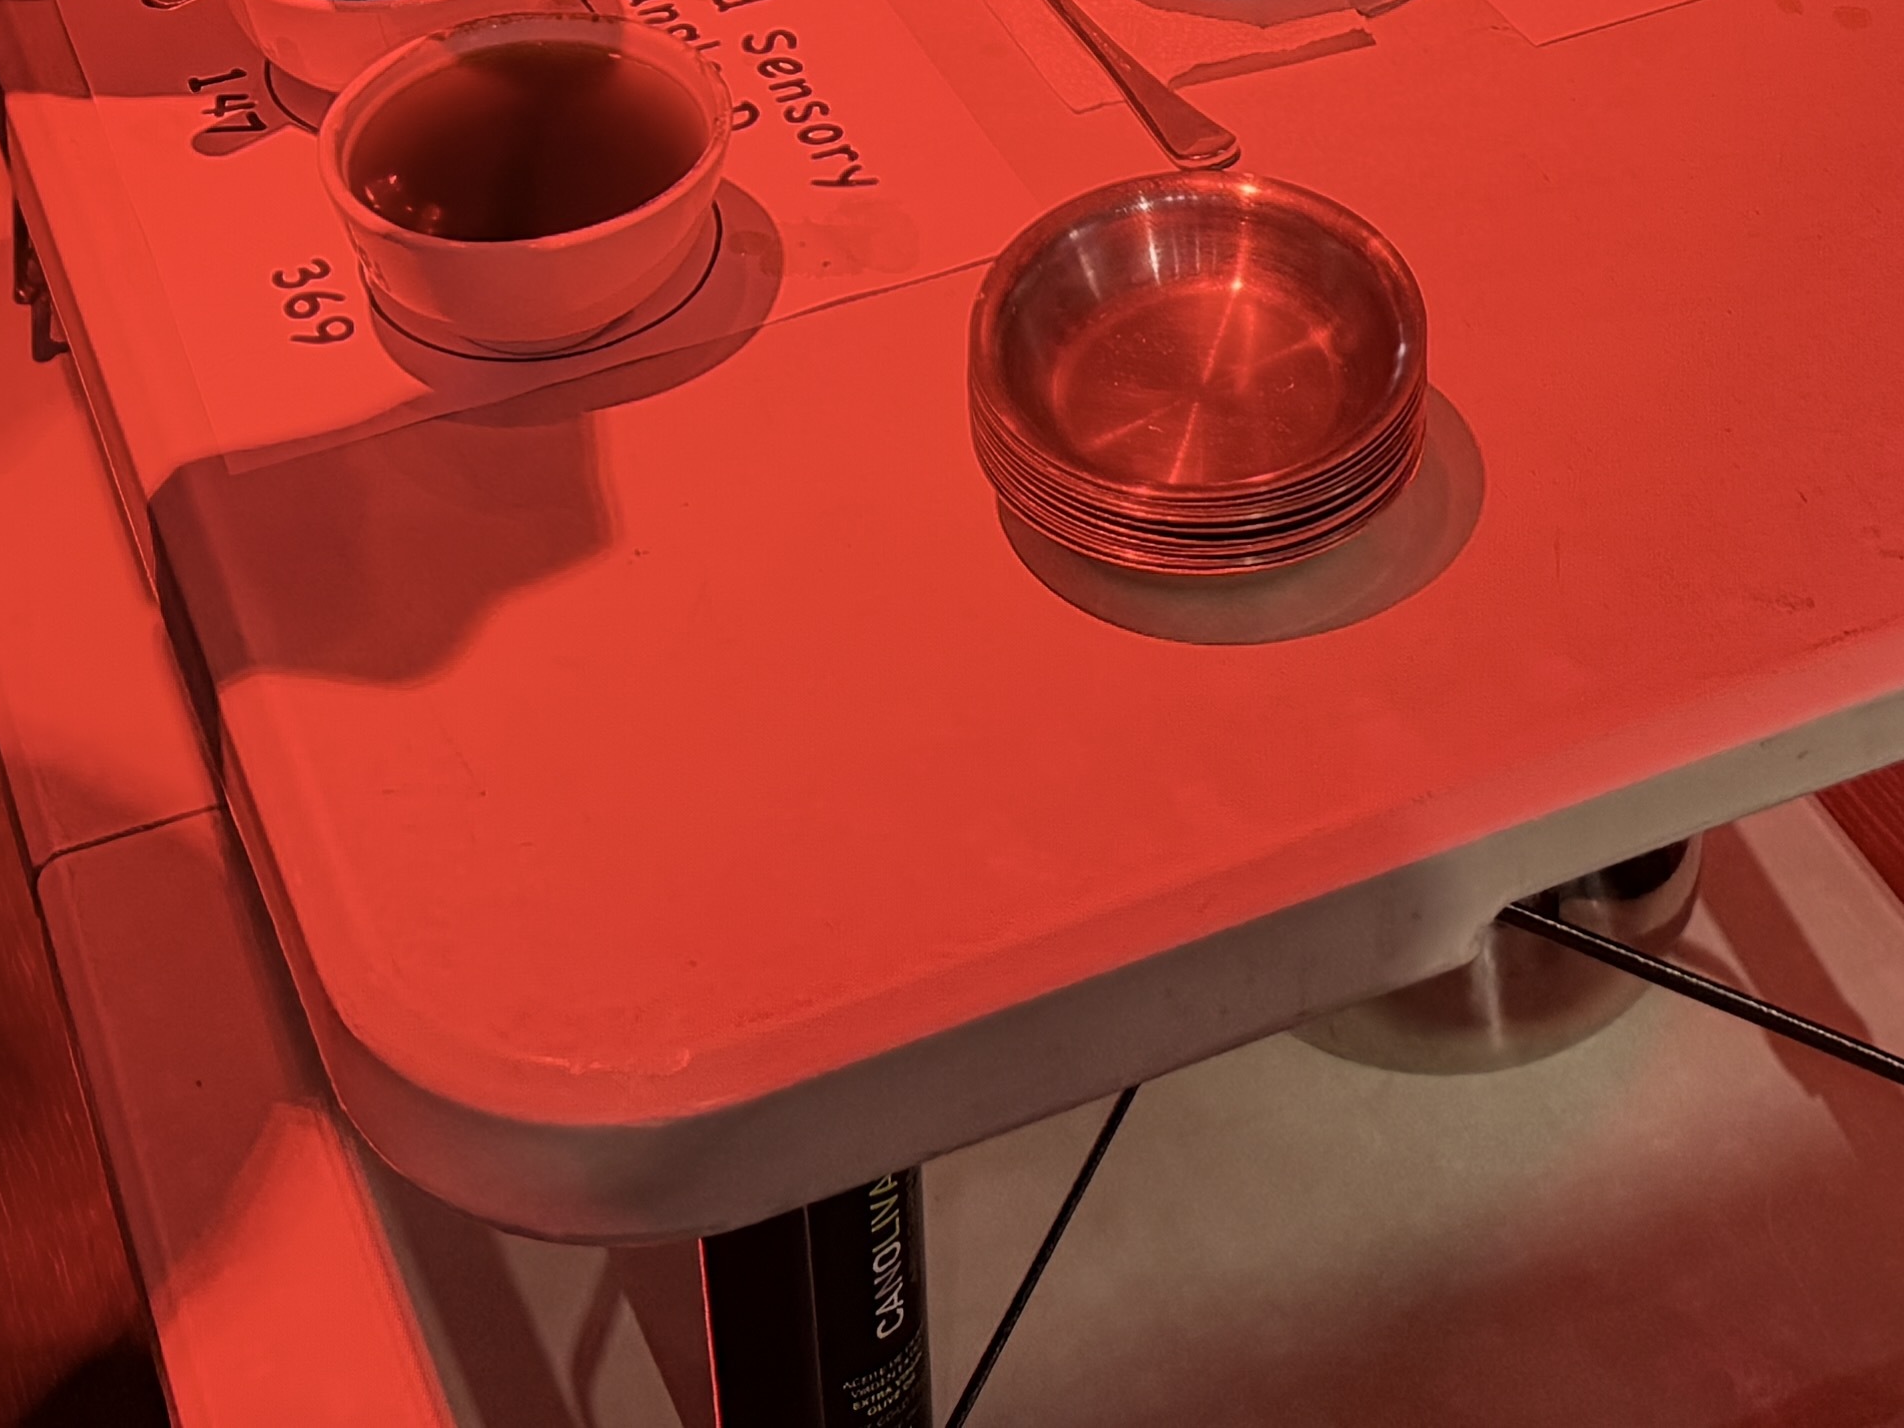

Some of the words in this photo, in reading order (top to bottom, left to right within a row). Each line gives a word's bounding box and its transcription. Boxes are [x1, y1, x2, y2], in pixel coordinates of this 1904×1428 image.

[188, 68, 267, 133] 147
[740, 28, 880, 188] Sensory
[271, 257, 355, 344] 369
[868, 1172, 905, 1340] CANOLIVA
